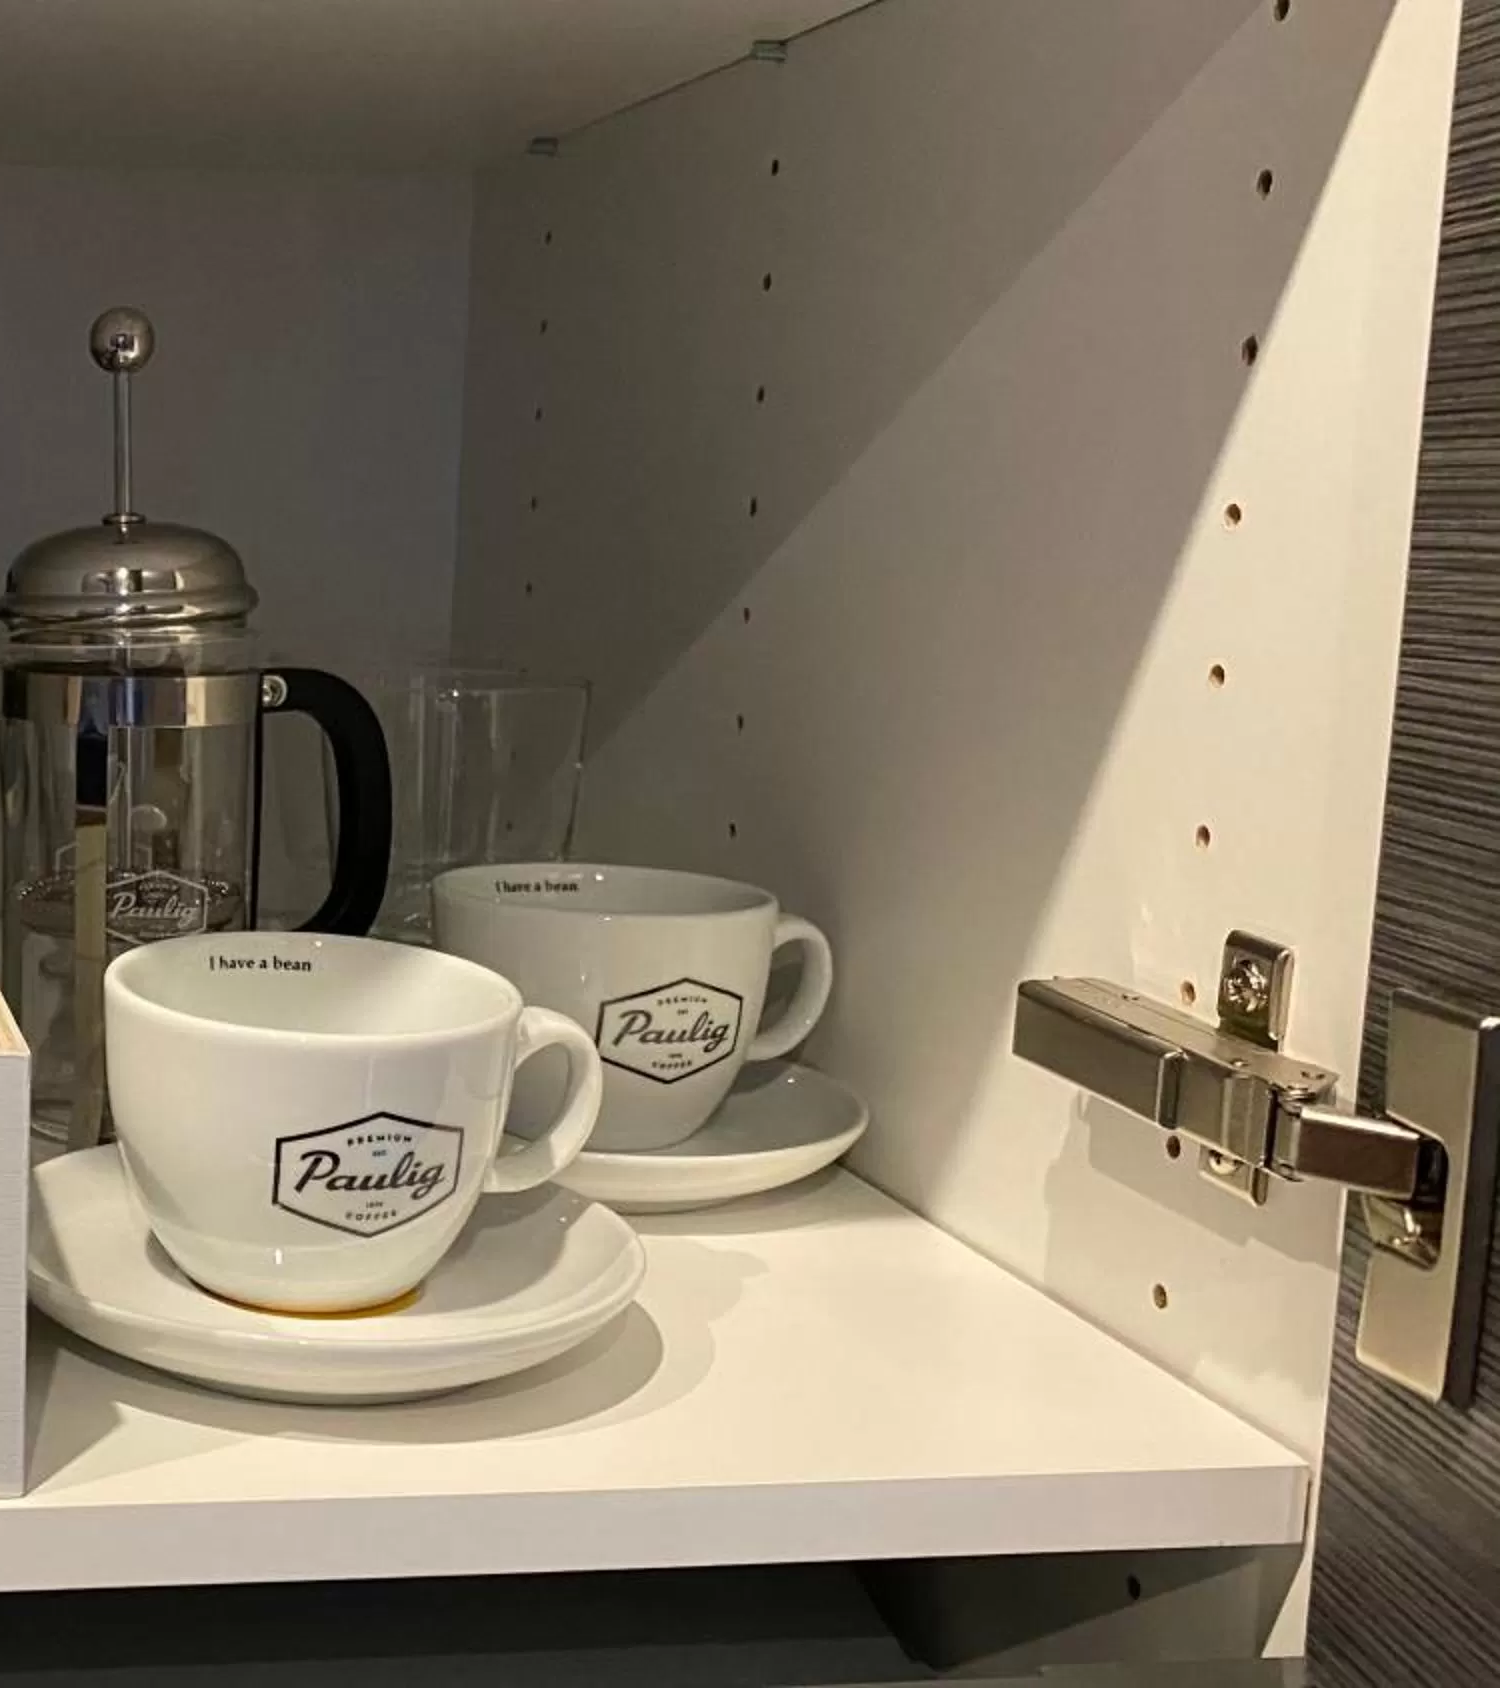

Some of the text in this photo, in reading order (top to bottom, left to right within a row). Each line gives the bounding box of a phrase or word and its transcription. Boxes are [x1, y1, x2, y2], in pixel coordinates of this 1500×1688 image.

[110, 891, 197, 929] Paulig
[209, 955, 312, 972] I have a bean
[612, 1009, 730, 1053] Paulig
[347, 1134, 412, 1147] PREMIUM
[294, 1150, 445, 1200] Paulig
